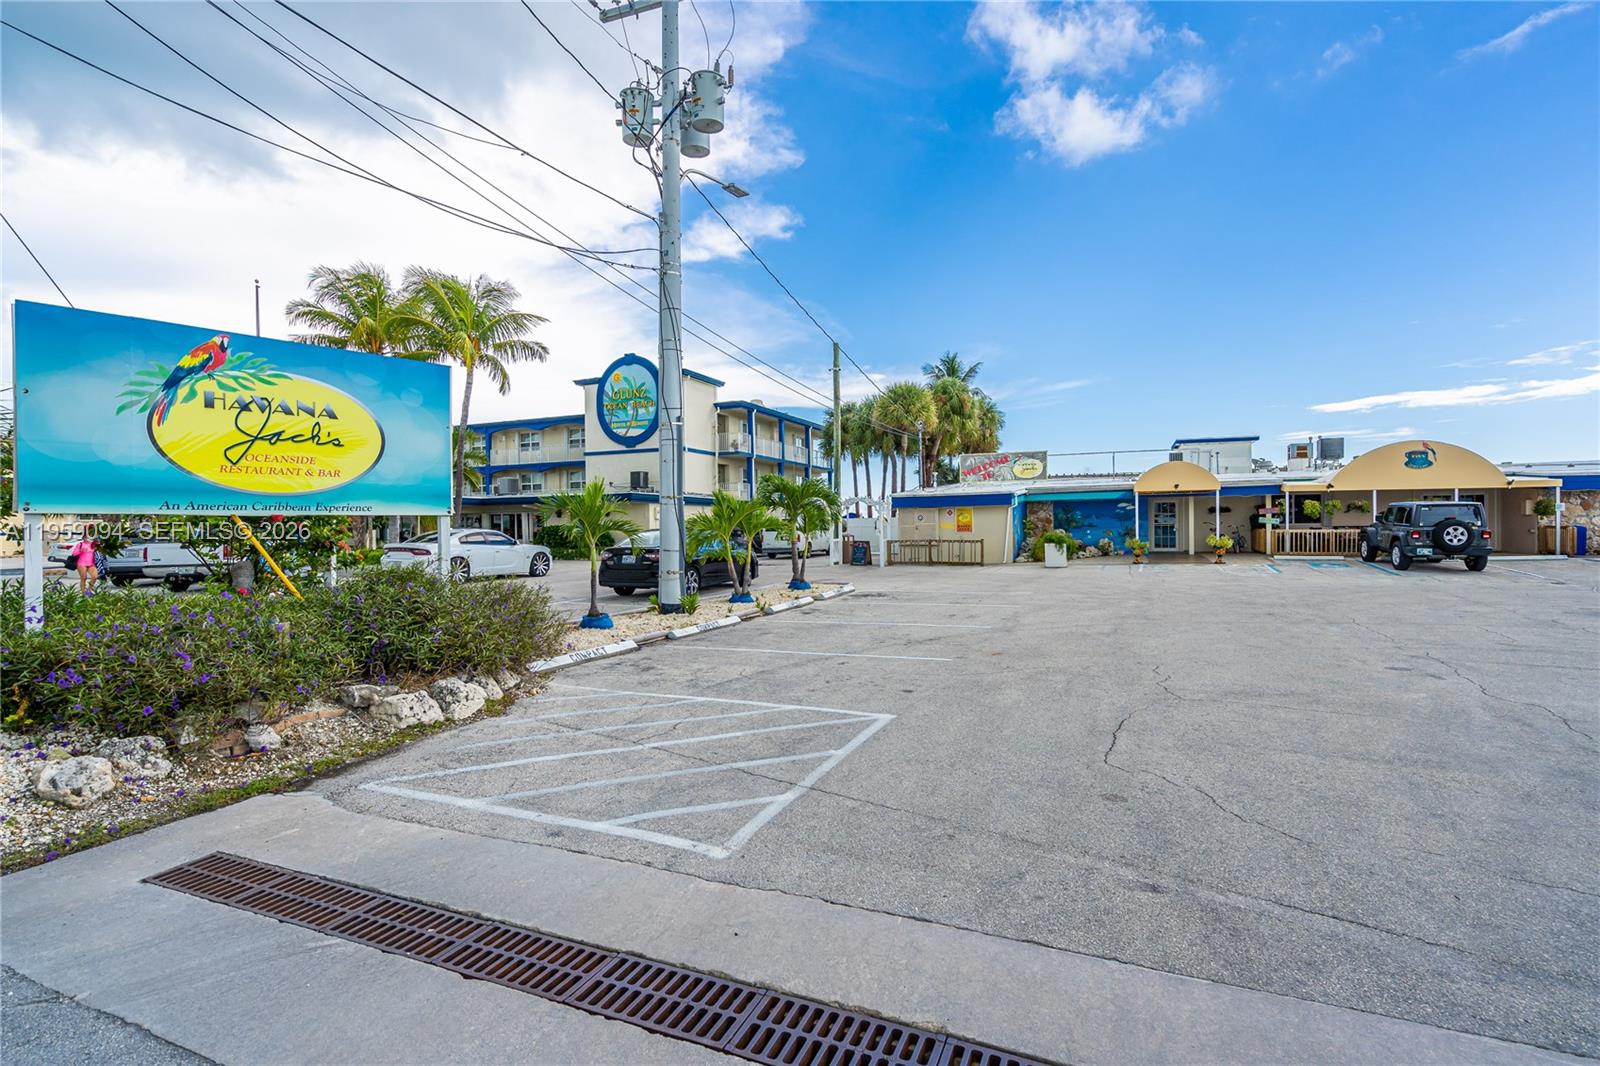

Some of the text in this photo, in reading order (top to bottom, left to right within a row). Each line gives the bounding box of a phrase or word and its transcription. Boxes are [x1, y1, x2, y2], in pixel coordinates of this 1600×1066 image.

[612, 387, 647, 400] GLUNZ
[204, 390, 339, 420] HAVANA
[224, 397, 344, 465] Jack's
[245, 453, 316, 465] OCEANSIDE
[220, 465, 341, 478] RESTAURANT & BAR
[159, 500, 373, 514] An American Caribbean Experience
[569, 646, 608, 662] COMPACT
